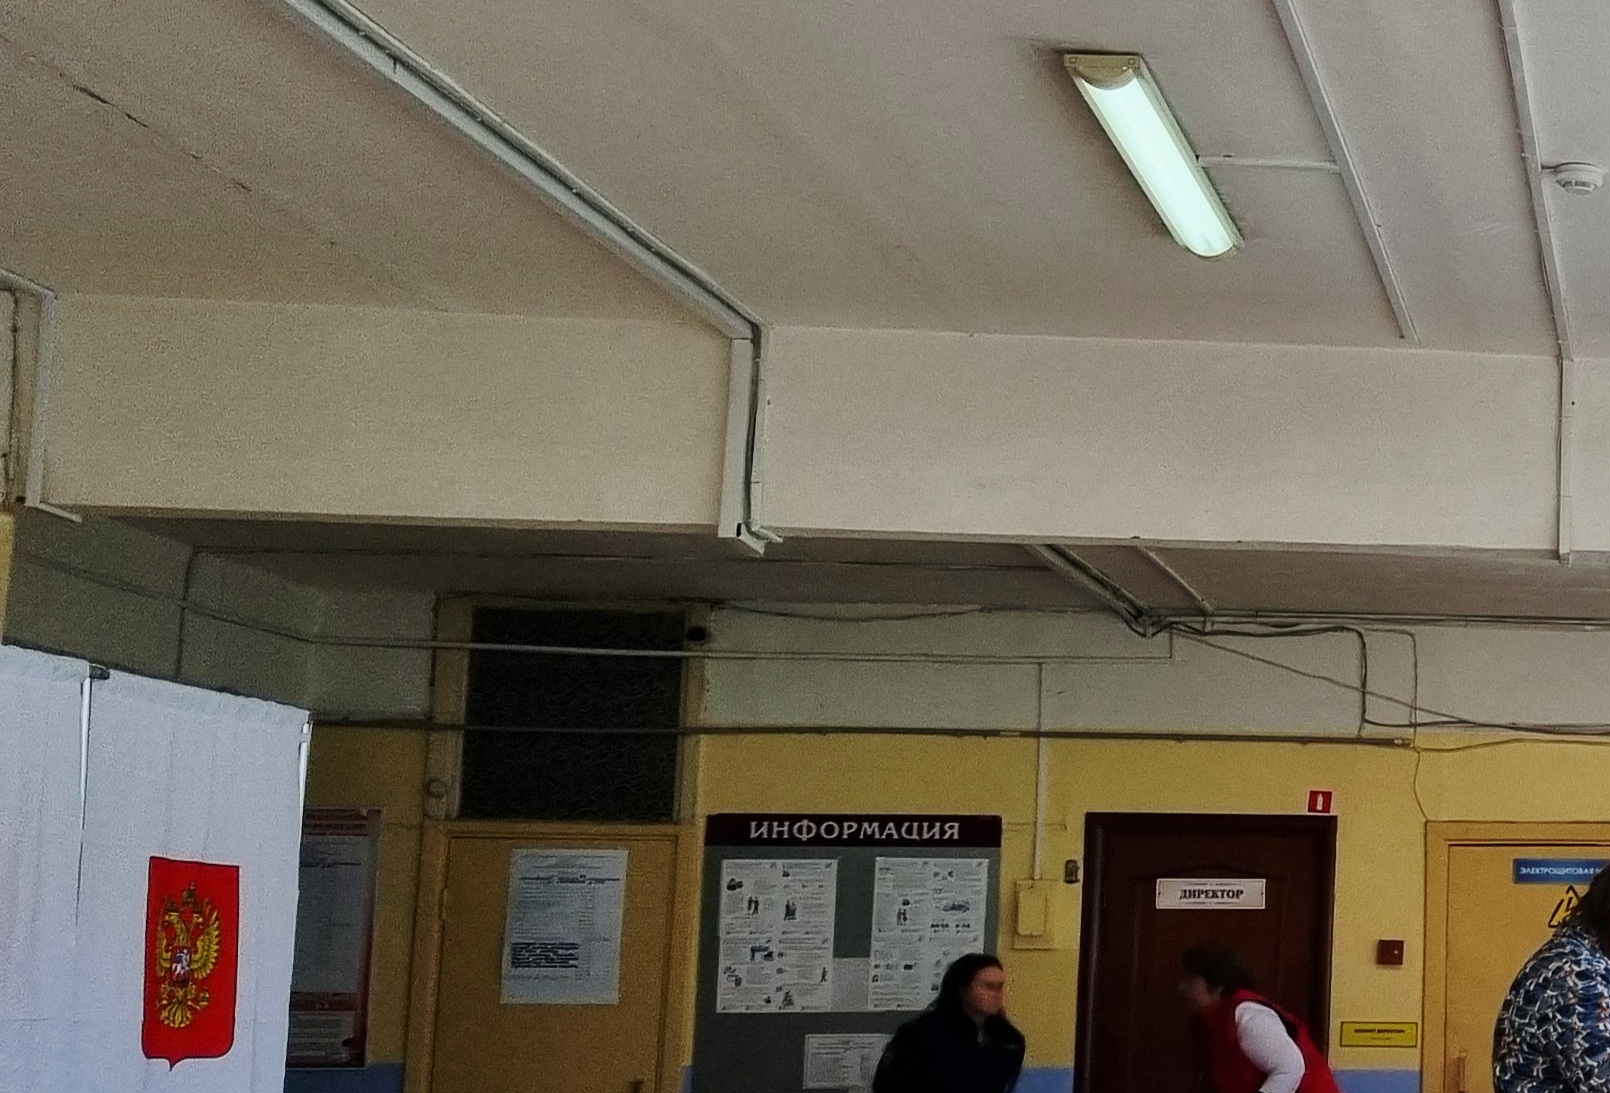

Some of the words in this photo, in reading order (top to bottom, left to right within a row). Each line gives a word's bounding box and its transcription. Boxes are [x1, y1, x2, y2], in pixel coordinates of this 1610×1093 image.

[749, 819, 960, 841] ИНФОРМАЦИЯ
[1519, 867, 1594, 875] ЭЛЕКТРОЩИТОВАЯ
[1179, 889, 1244, 900] ДИРЕКТОР
